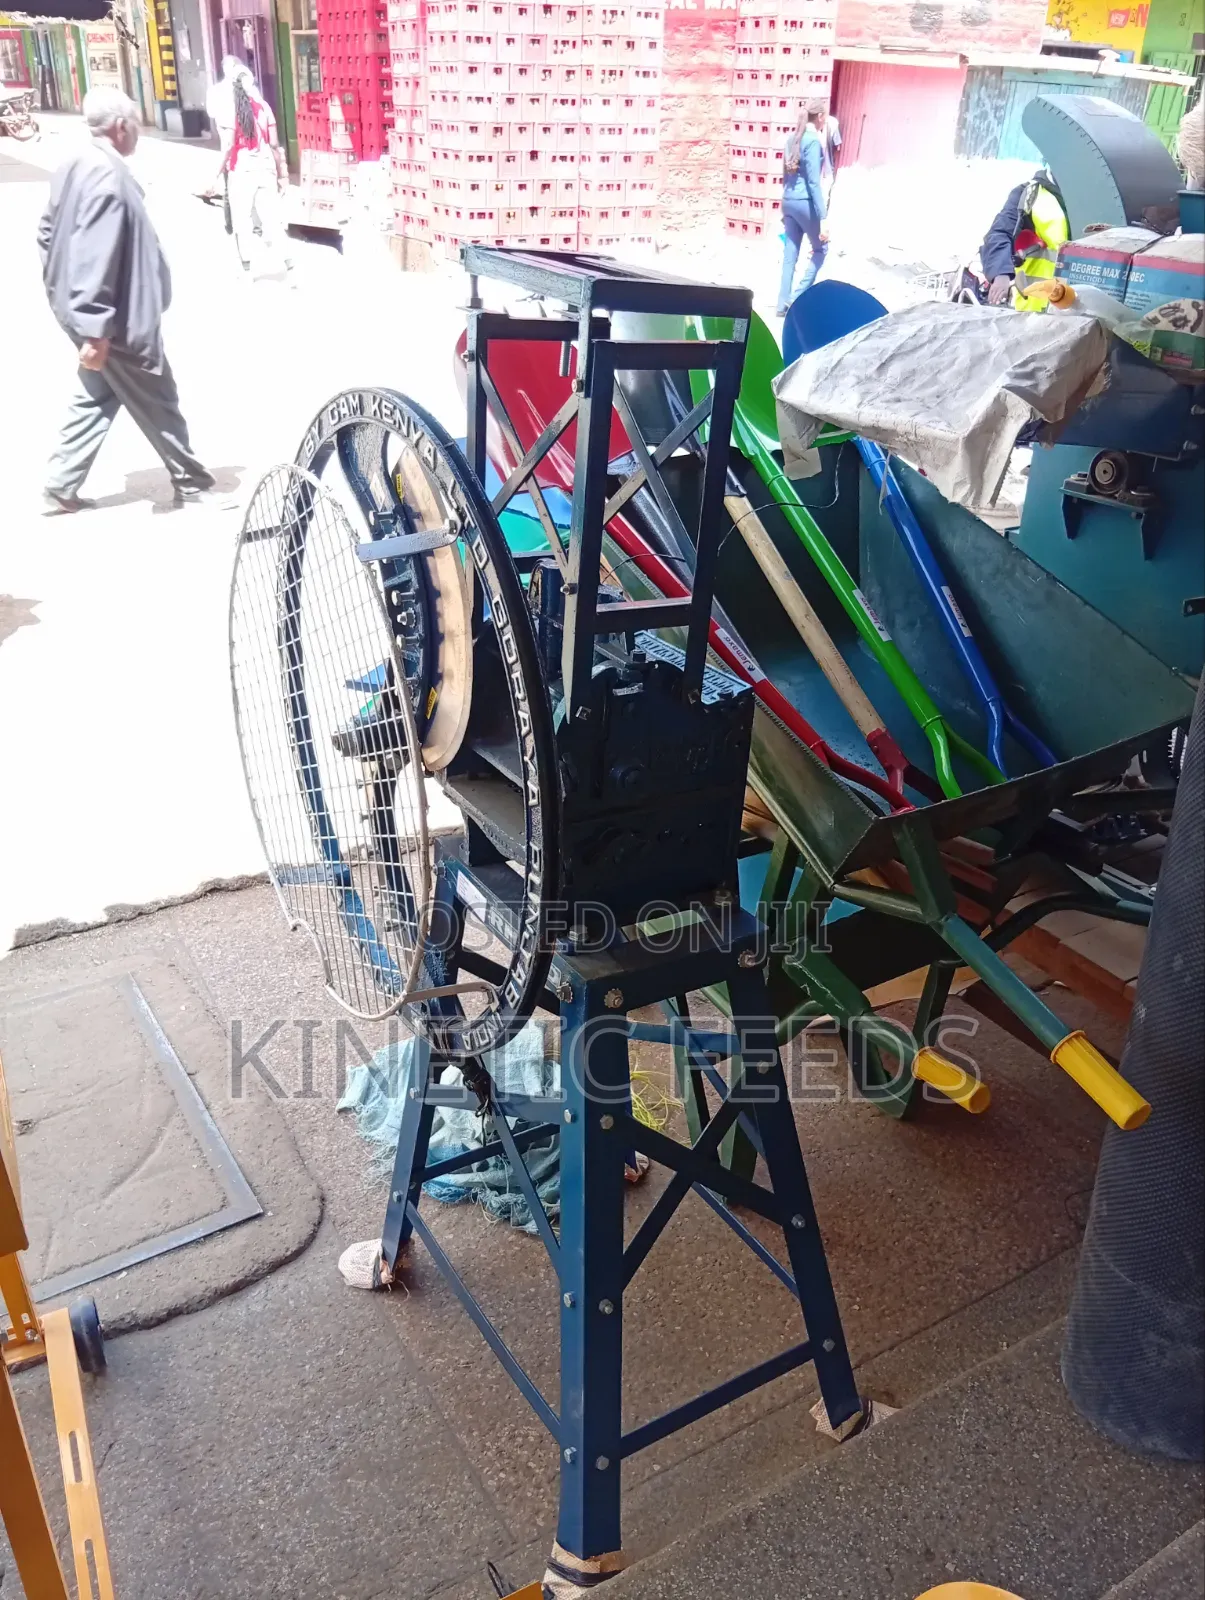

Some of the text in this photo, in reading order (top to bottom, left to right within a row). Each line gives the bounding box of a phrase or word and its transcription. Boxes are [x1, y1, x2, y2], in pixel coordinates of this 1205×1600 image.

[1070, 262, 1101, 276] DEGREE
[1102, 267, 1121, 279] MAX
[328, 394, 362, 425] GAM
[303, 420, 322, 459] BY
[371, 395, 437, 471] KENYA
[448, 479, 489, 570] LTD
[492, 594, 540, 807] GORAYA
[461, 1011, 505, 1050] INDIA
